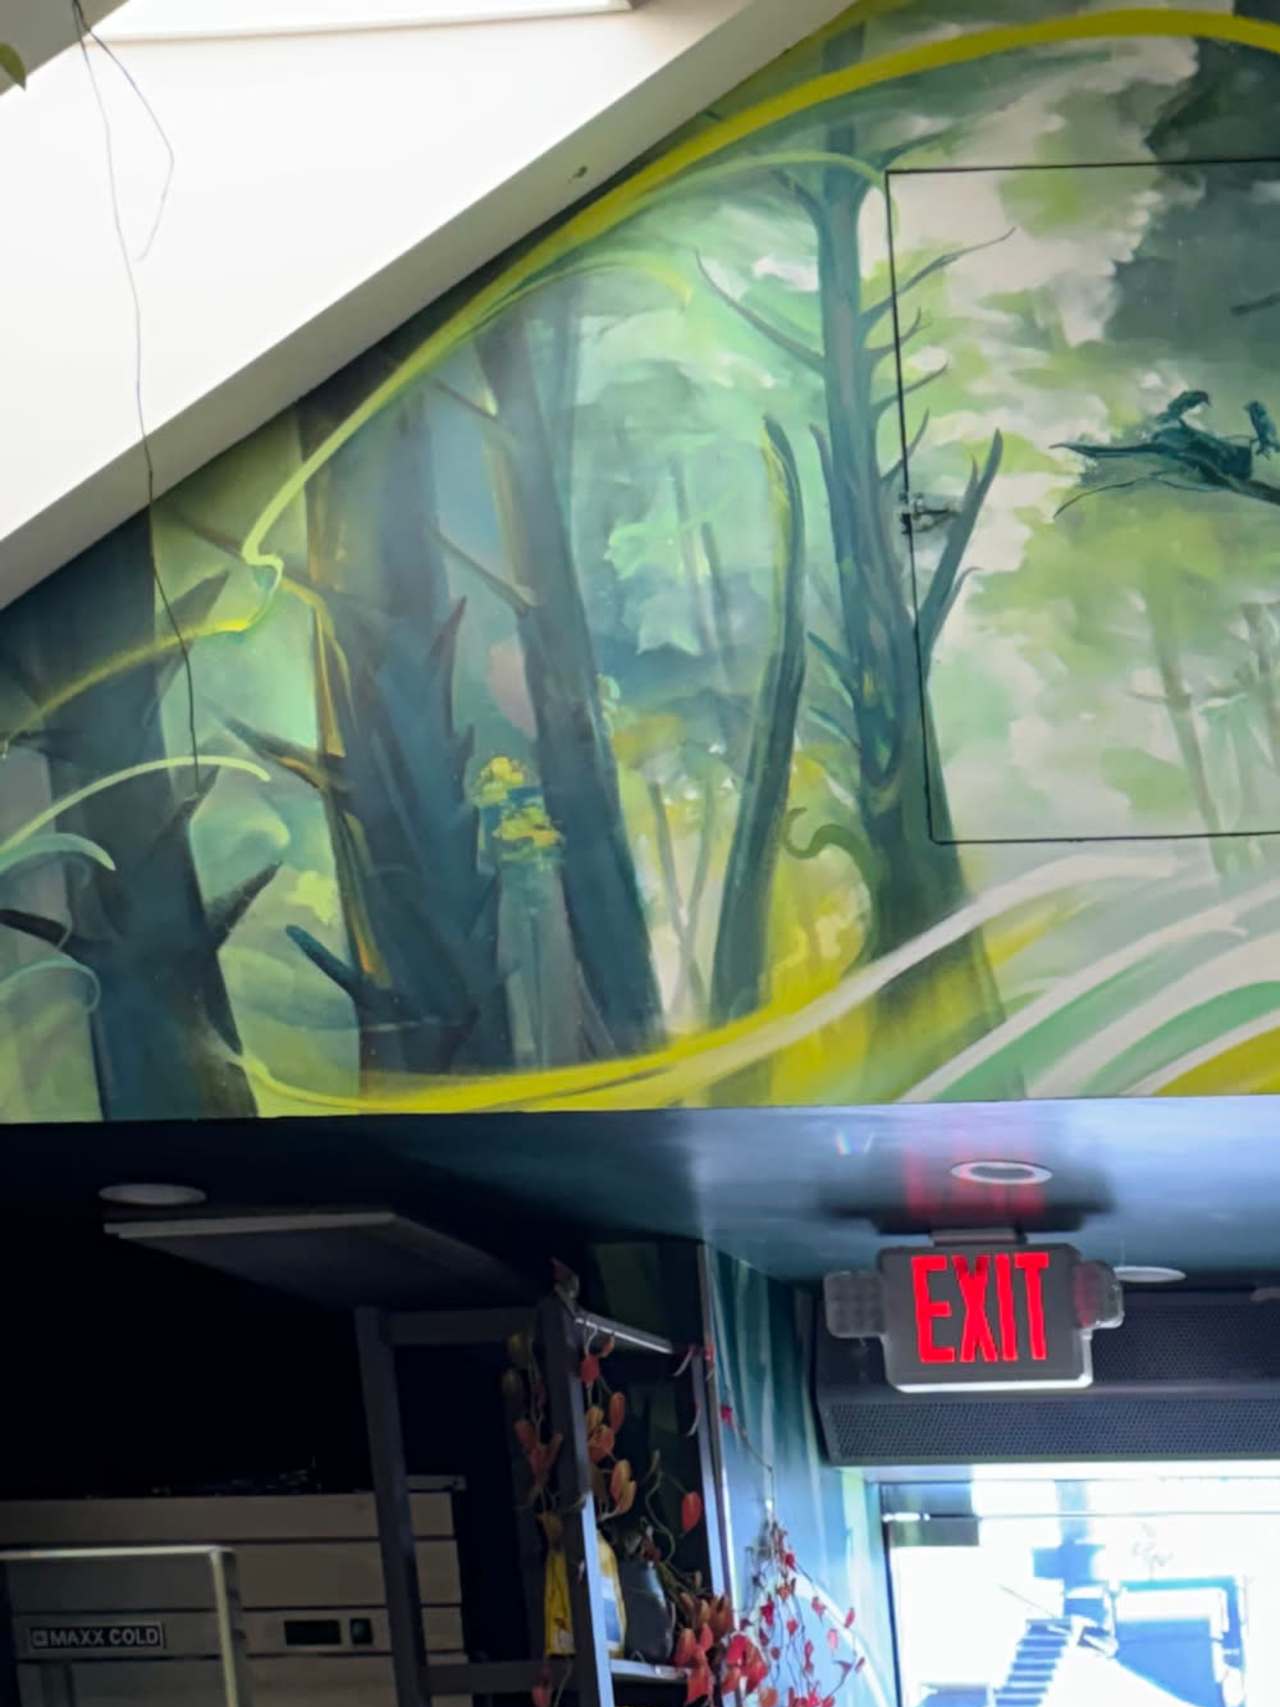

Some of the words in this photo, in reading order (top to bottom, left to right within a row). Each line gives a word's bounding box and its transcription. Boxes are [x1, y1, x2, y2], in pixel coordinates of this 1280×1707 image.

[911, 1252, 1049, 1364] EXIT
[51, 1630, 104, 1646] MAXX
[109, 1629, 159, 1645] COLD
